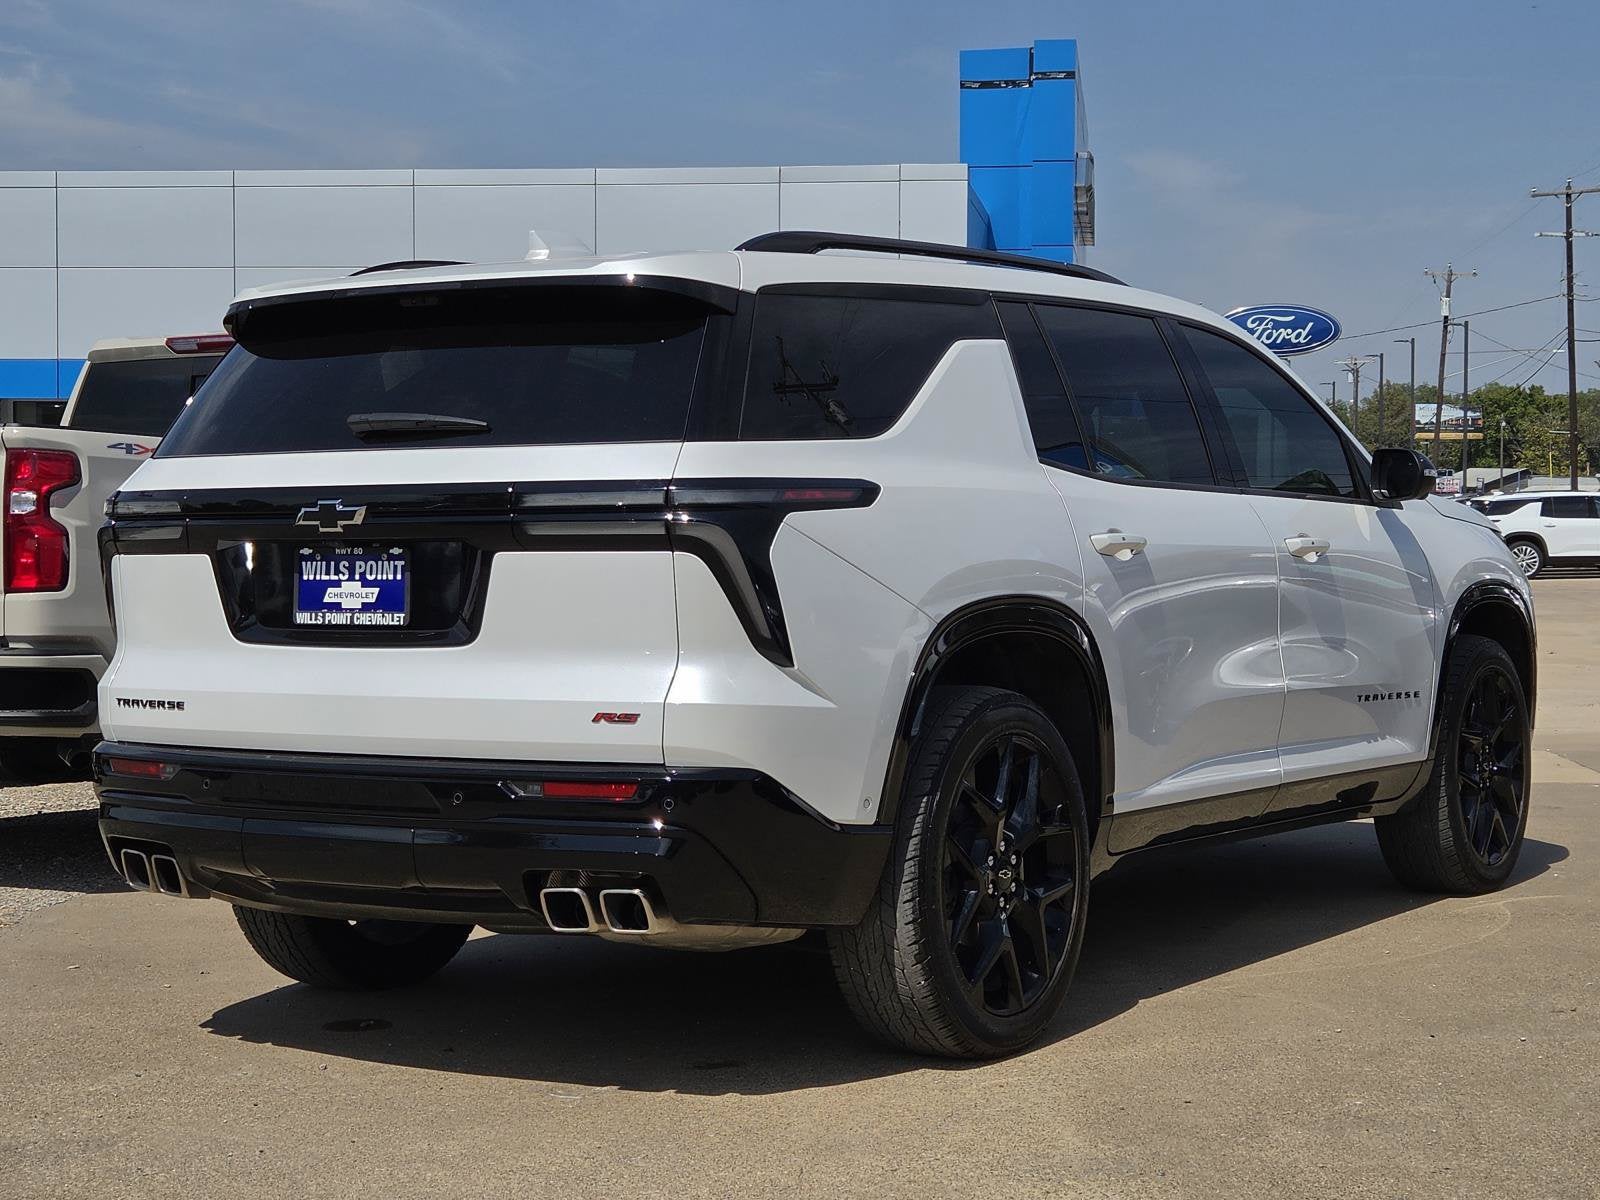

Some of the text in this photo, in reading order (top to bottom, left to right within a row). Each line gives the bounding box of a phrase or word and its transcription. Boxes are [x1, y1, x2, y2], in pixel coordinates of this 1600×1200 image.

[1247, 315, 1313, 344] Ford
[335, 547, 363, 555] HWY 80
[302, 560, 405, 580] WILLS POINT
[296, 612, 405, 626] WILLS POINT CHEVROLET
[1357, 691, 1420, 702] TRAVERSE
[115, 698, 185, 711] TRAVERSE
[592, 713, 640, 724] RS
